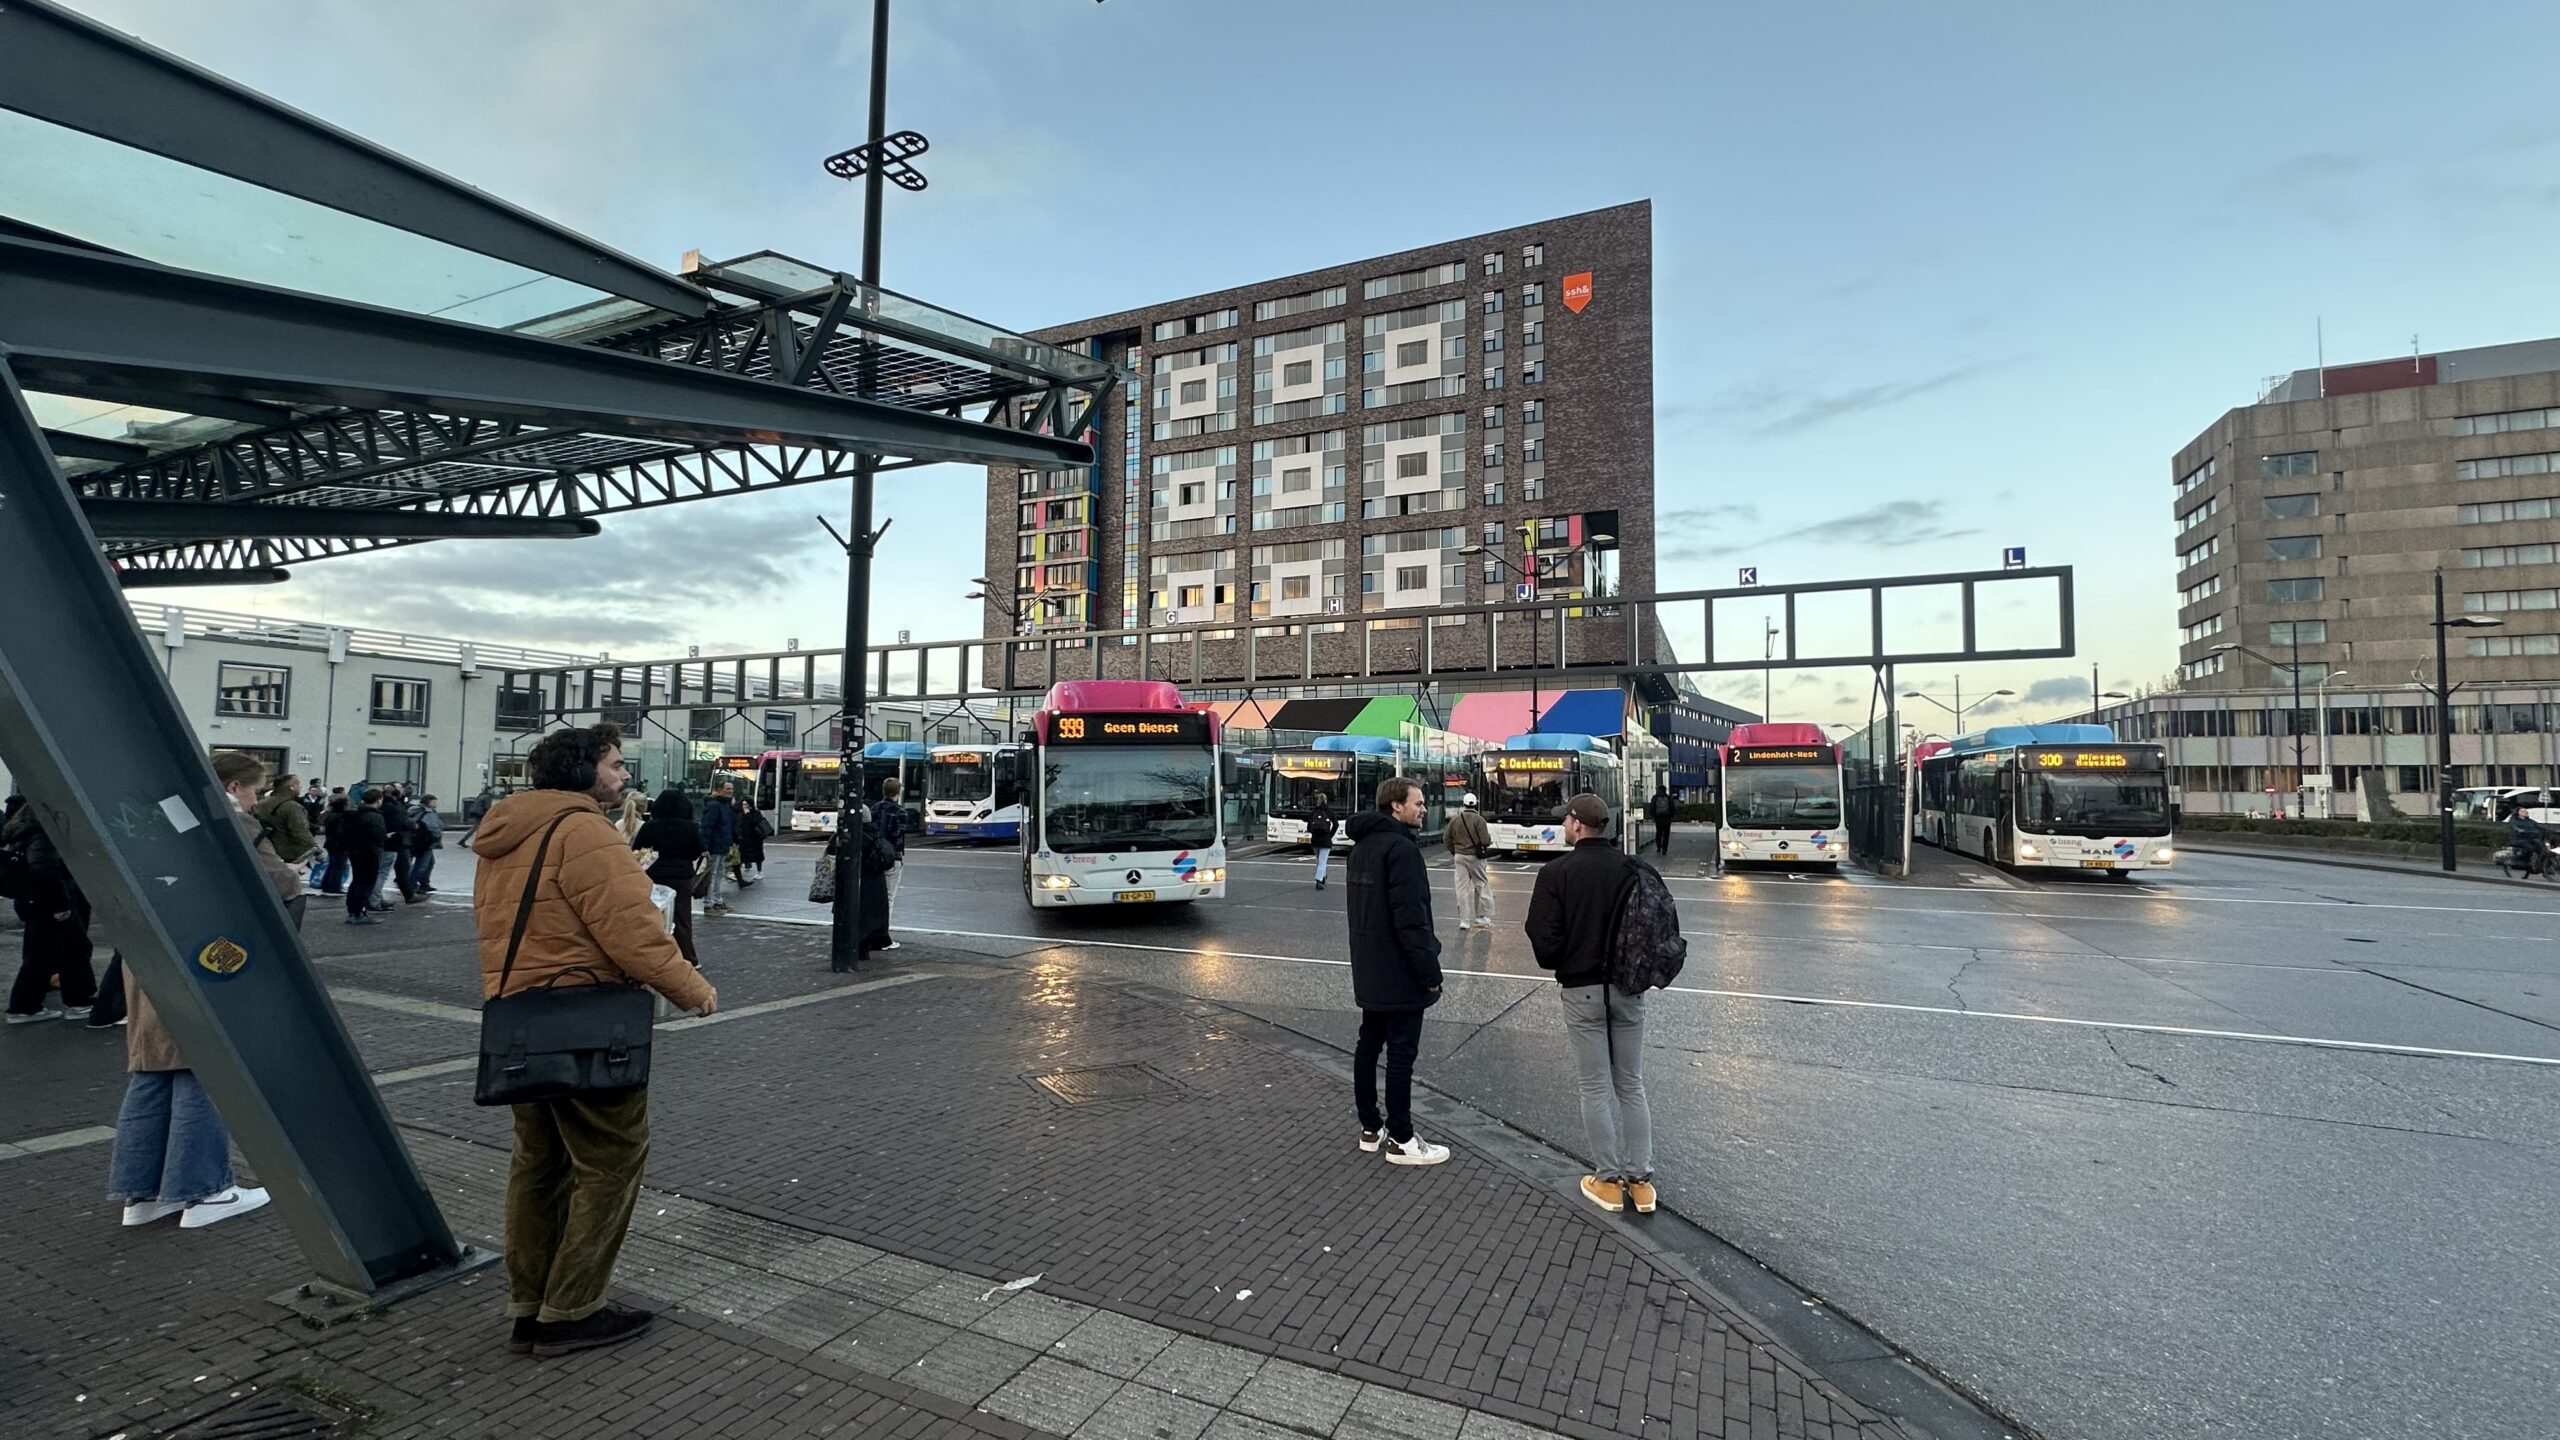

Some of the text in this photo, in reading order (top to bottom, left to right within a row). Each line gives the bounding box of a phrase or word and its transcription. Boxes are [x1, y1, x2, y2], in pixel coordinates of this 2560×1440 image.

[1565, 285, 1589, 297] ssh&
[1059, 718, 1179, 738] 999 Geen Dienst
[1733, 749, 1741, 762] 2
[2039, 753, 2063, 767] 300
[1499, 757, 1563, 769] 3 Oosterhout
[2081, 848, 2113, 856] MAN
[1072, 855, 1097, 864] breng
